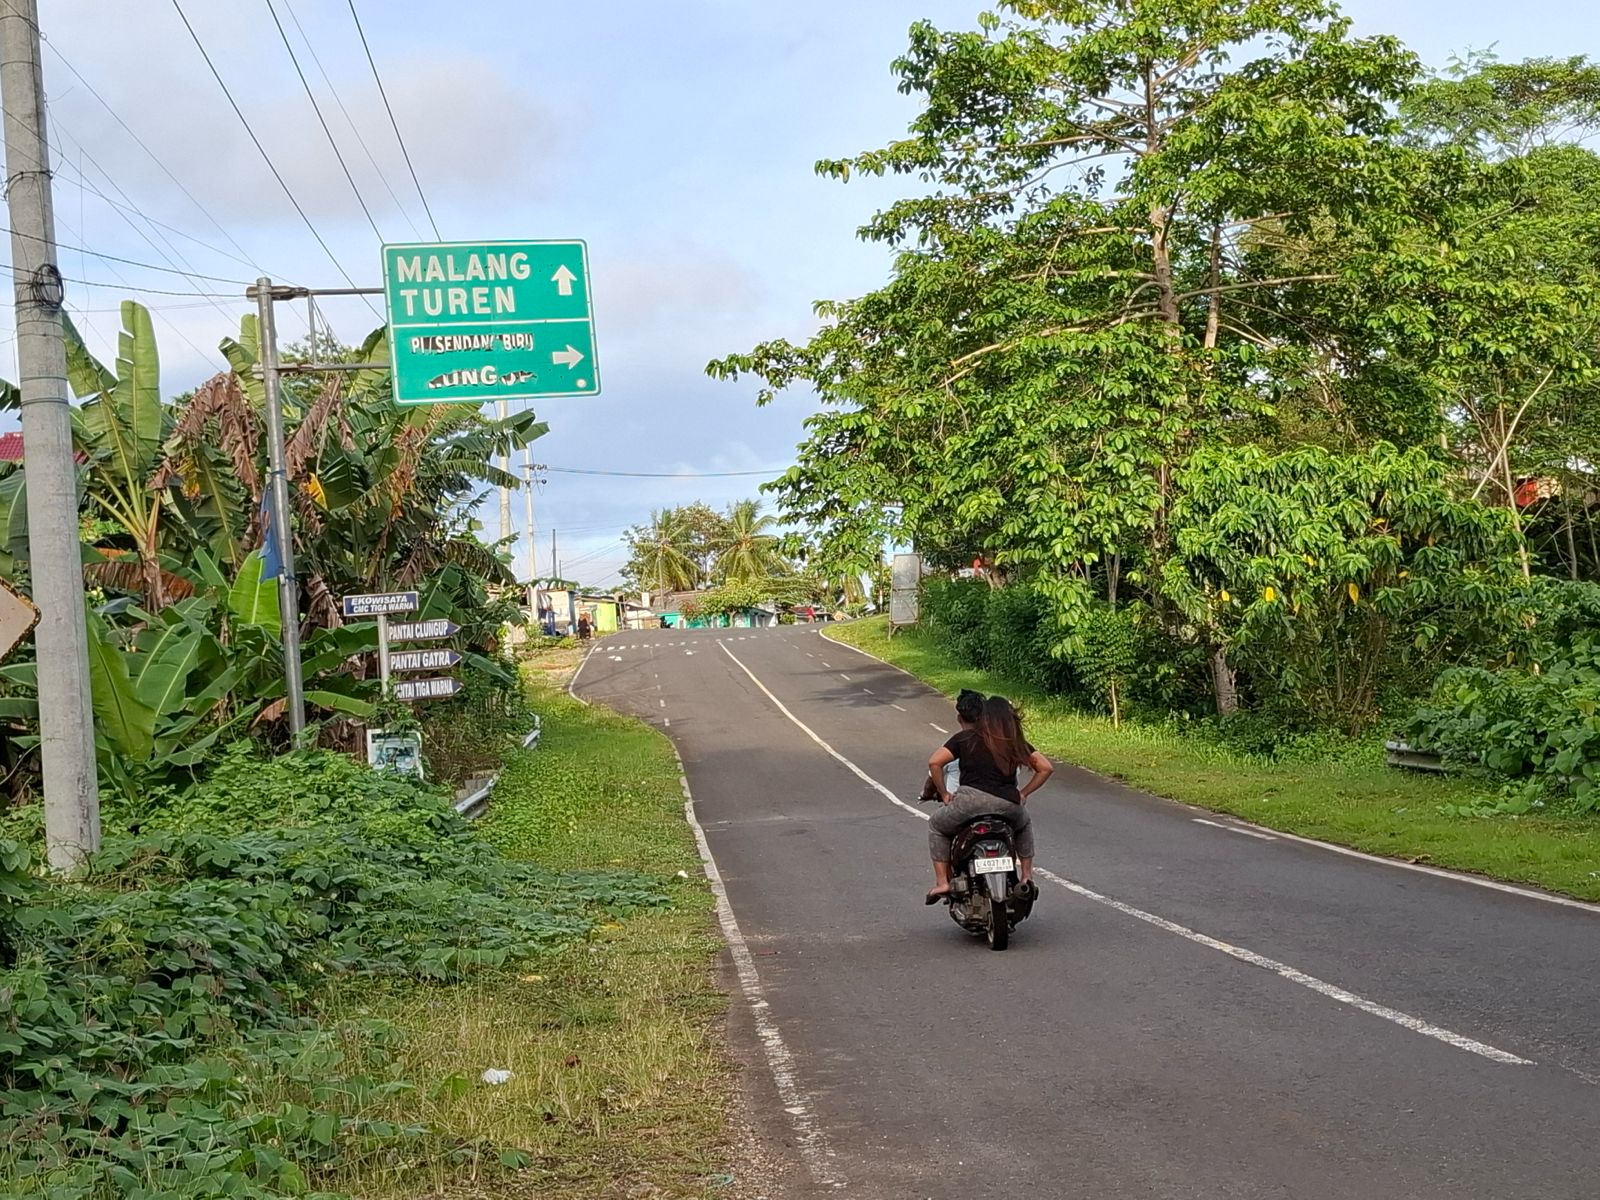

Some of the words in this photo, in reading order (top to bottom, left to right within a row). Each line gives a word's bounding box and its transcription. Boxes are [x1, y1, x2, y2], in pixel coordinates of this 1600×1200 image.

[397, 252, 531, 283] MALANG
[400, 286, 516, 316] TUREN
[351, 595, 407, 605] EKOWISATA
[370, 604, 387, 612] TIGA
[388, 602, 414, 611] WARNA
[389, 624, 414, 640] PANTAI
[415, 621, 448, 638] CLUNGUP
[391, 653, 420, 670] PANTAI
[422, 651, 451, 667] GATRA
[415, 681, 431, 697] TIGA
[430, 679, 453, 695] WARNA
